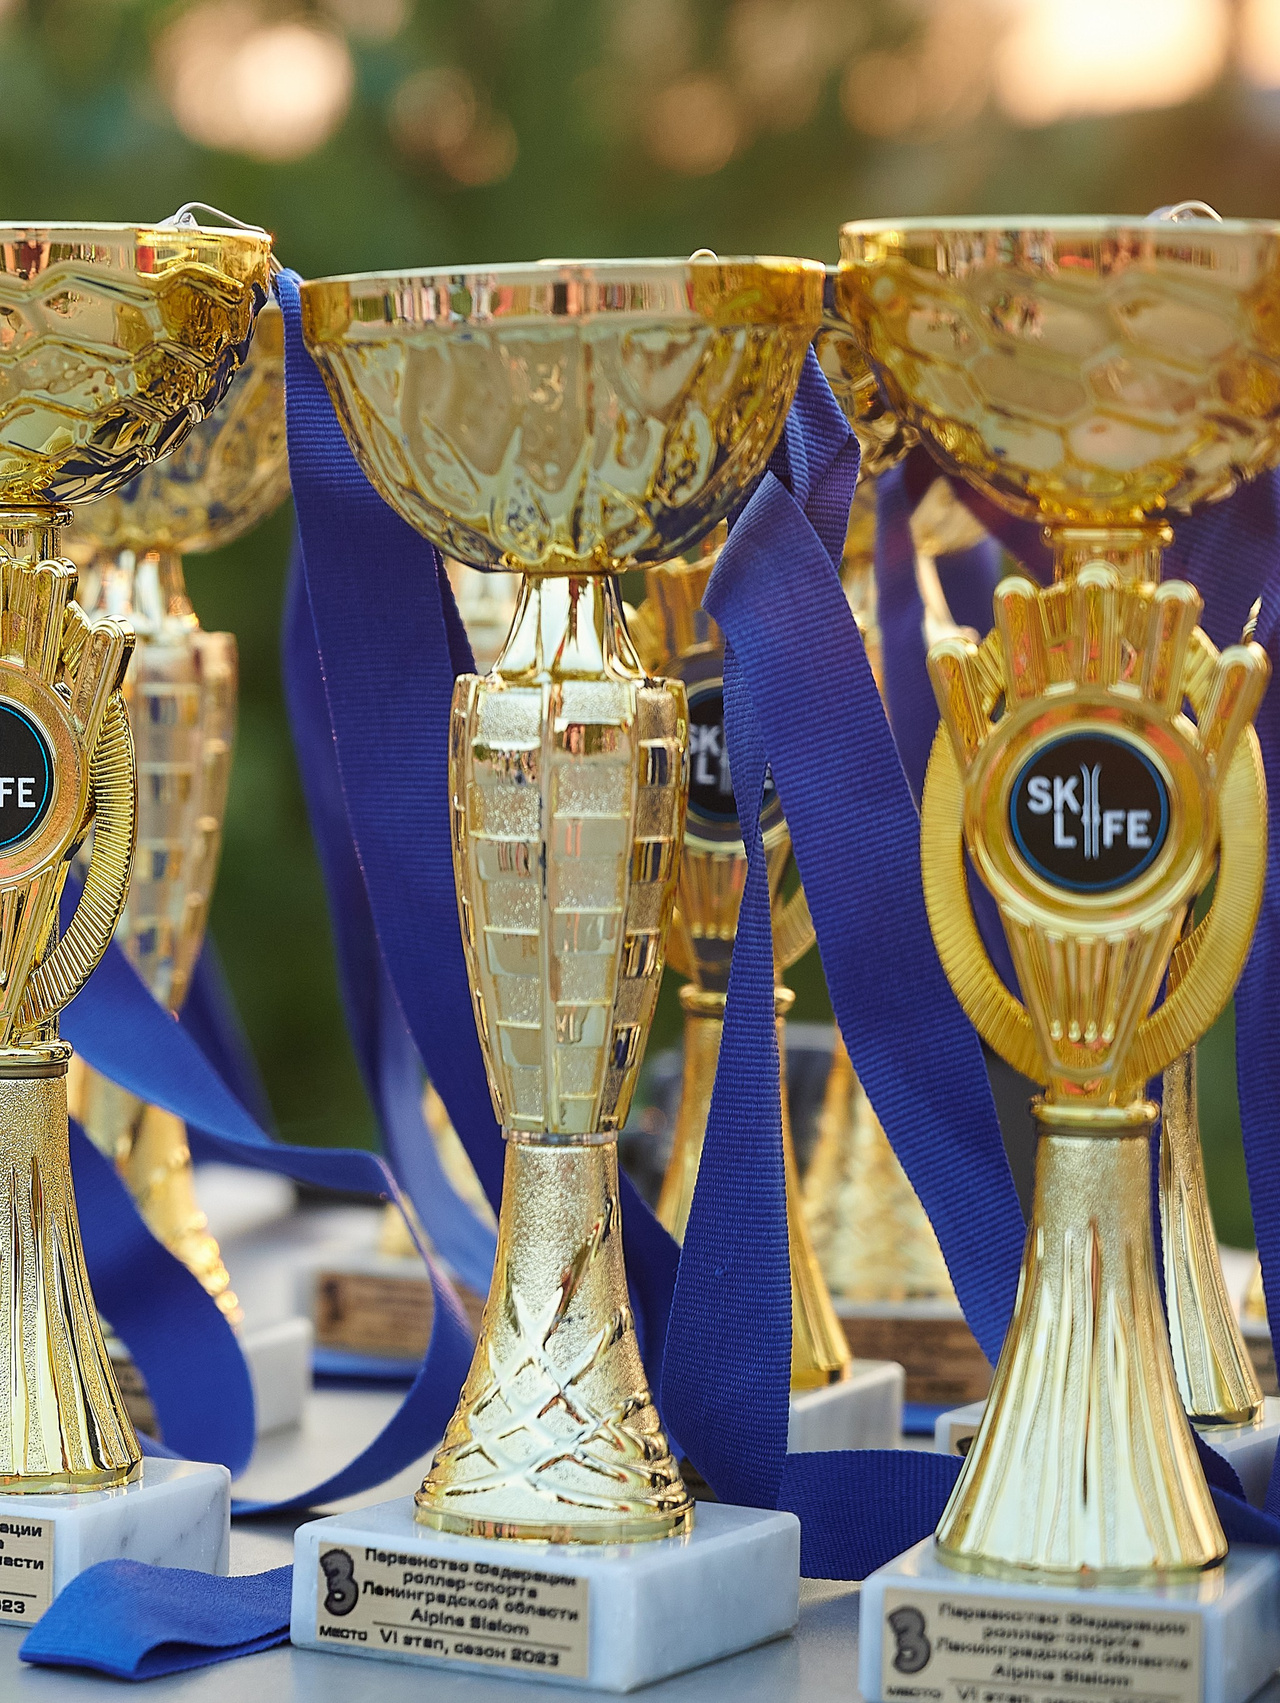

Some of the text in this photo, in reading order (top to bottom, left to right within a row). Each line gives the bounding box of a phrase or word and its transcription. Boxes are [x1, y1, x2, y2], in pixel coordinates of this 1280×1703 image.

[320, 1549, 359, 1616] 3
[365, 1548, 576, 1586] Первенство Федерации
[403, 1572, 537, 1599] роллер-спорта
[362, 1581, 578, 1621] Ленинградской области
[411, 1610, 529, 1635] Alpine Slalom
[887, 1605, 931, 1674] 3
[379, 1629, 559, 1666] VI этап, сезон 2023
